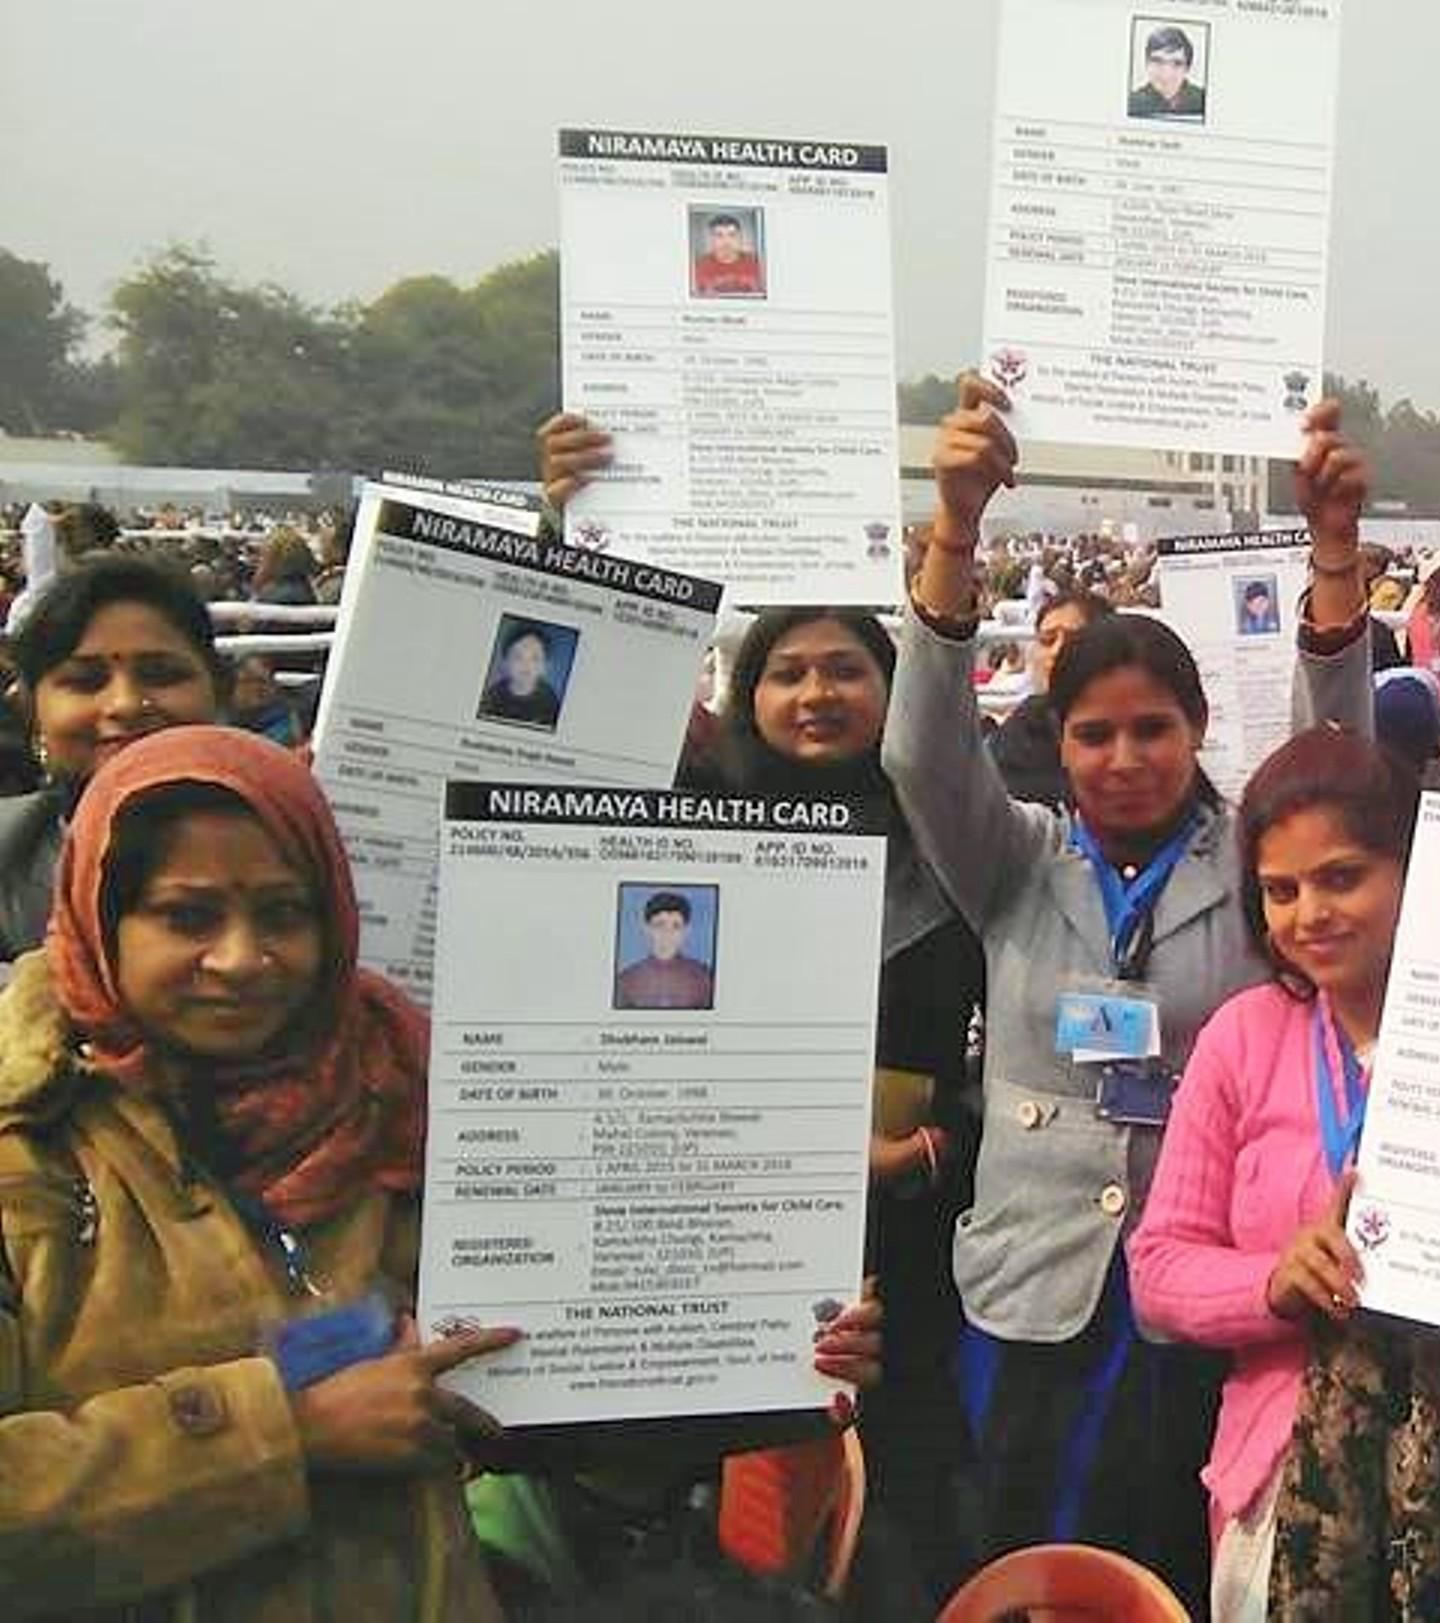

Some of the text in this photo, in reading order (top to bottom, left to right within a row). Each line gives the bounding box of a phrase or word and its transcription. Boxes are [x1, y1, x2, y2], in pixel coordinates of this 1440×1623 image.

[587, 133, 860, 168] NIRAMAYA HEALTH CARD
[1294, 529, 1314, 545] CA
[410, 515, 541, 563] NIRAMAYA
[544, 548, 631, 584] HEALTH
[487, 788, 851, 827] NIRAMAYA HEALTH CARD
[449, 825, 497, 841] POLICY
[462, 1032, 504, 1045] NAME
[460, 1060, 517, 1073] GENDER
[458, 1087, 495, 1101] DATE
[517, 1086, 559, 1100] BIRTH
[456, 1128, 520, 1142] ADDRESS
[455, 1162, 557, 1176] POLICY PERIOD
[453, 1182, 556, 1198] RENEWAL DATE
[629, 1200, 710, 1215] International
[713, 1199, 760, 1213] Society
[759, 1198, 779, 1212] for
[780, 1198, 813, 1211] Child
[451, 1235, 534, 1251] REGISTERED
[450, 1250, 555, 1267] ORGANIZATION
[563, 1299, 729, 1320] THE NATIONAL TRUST
